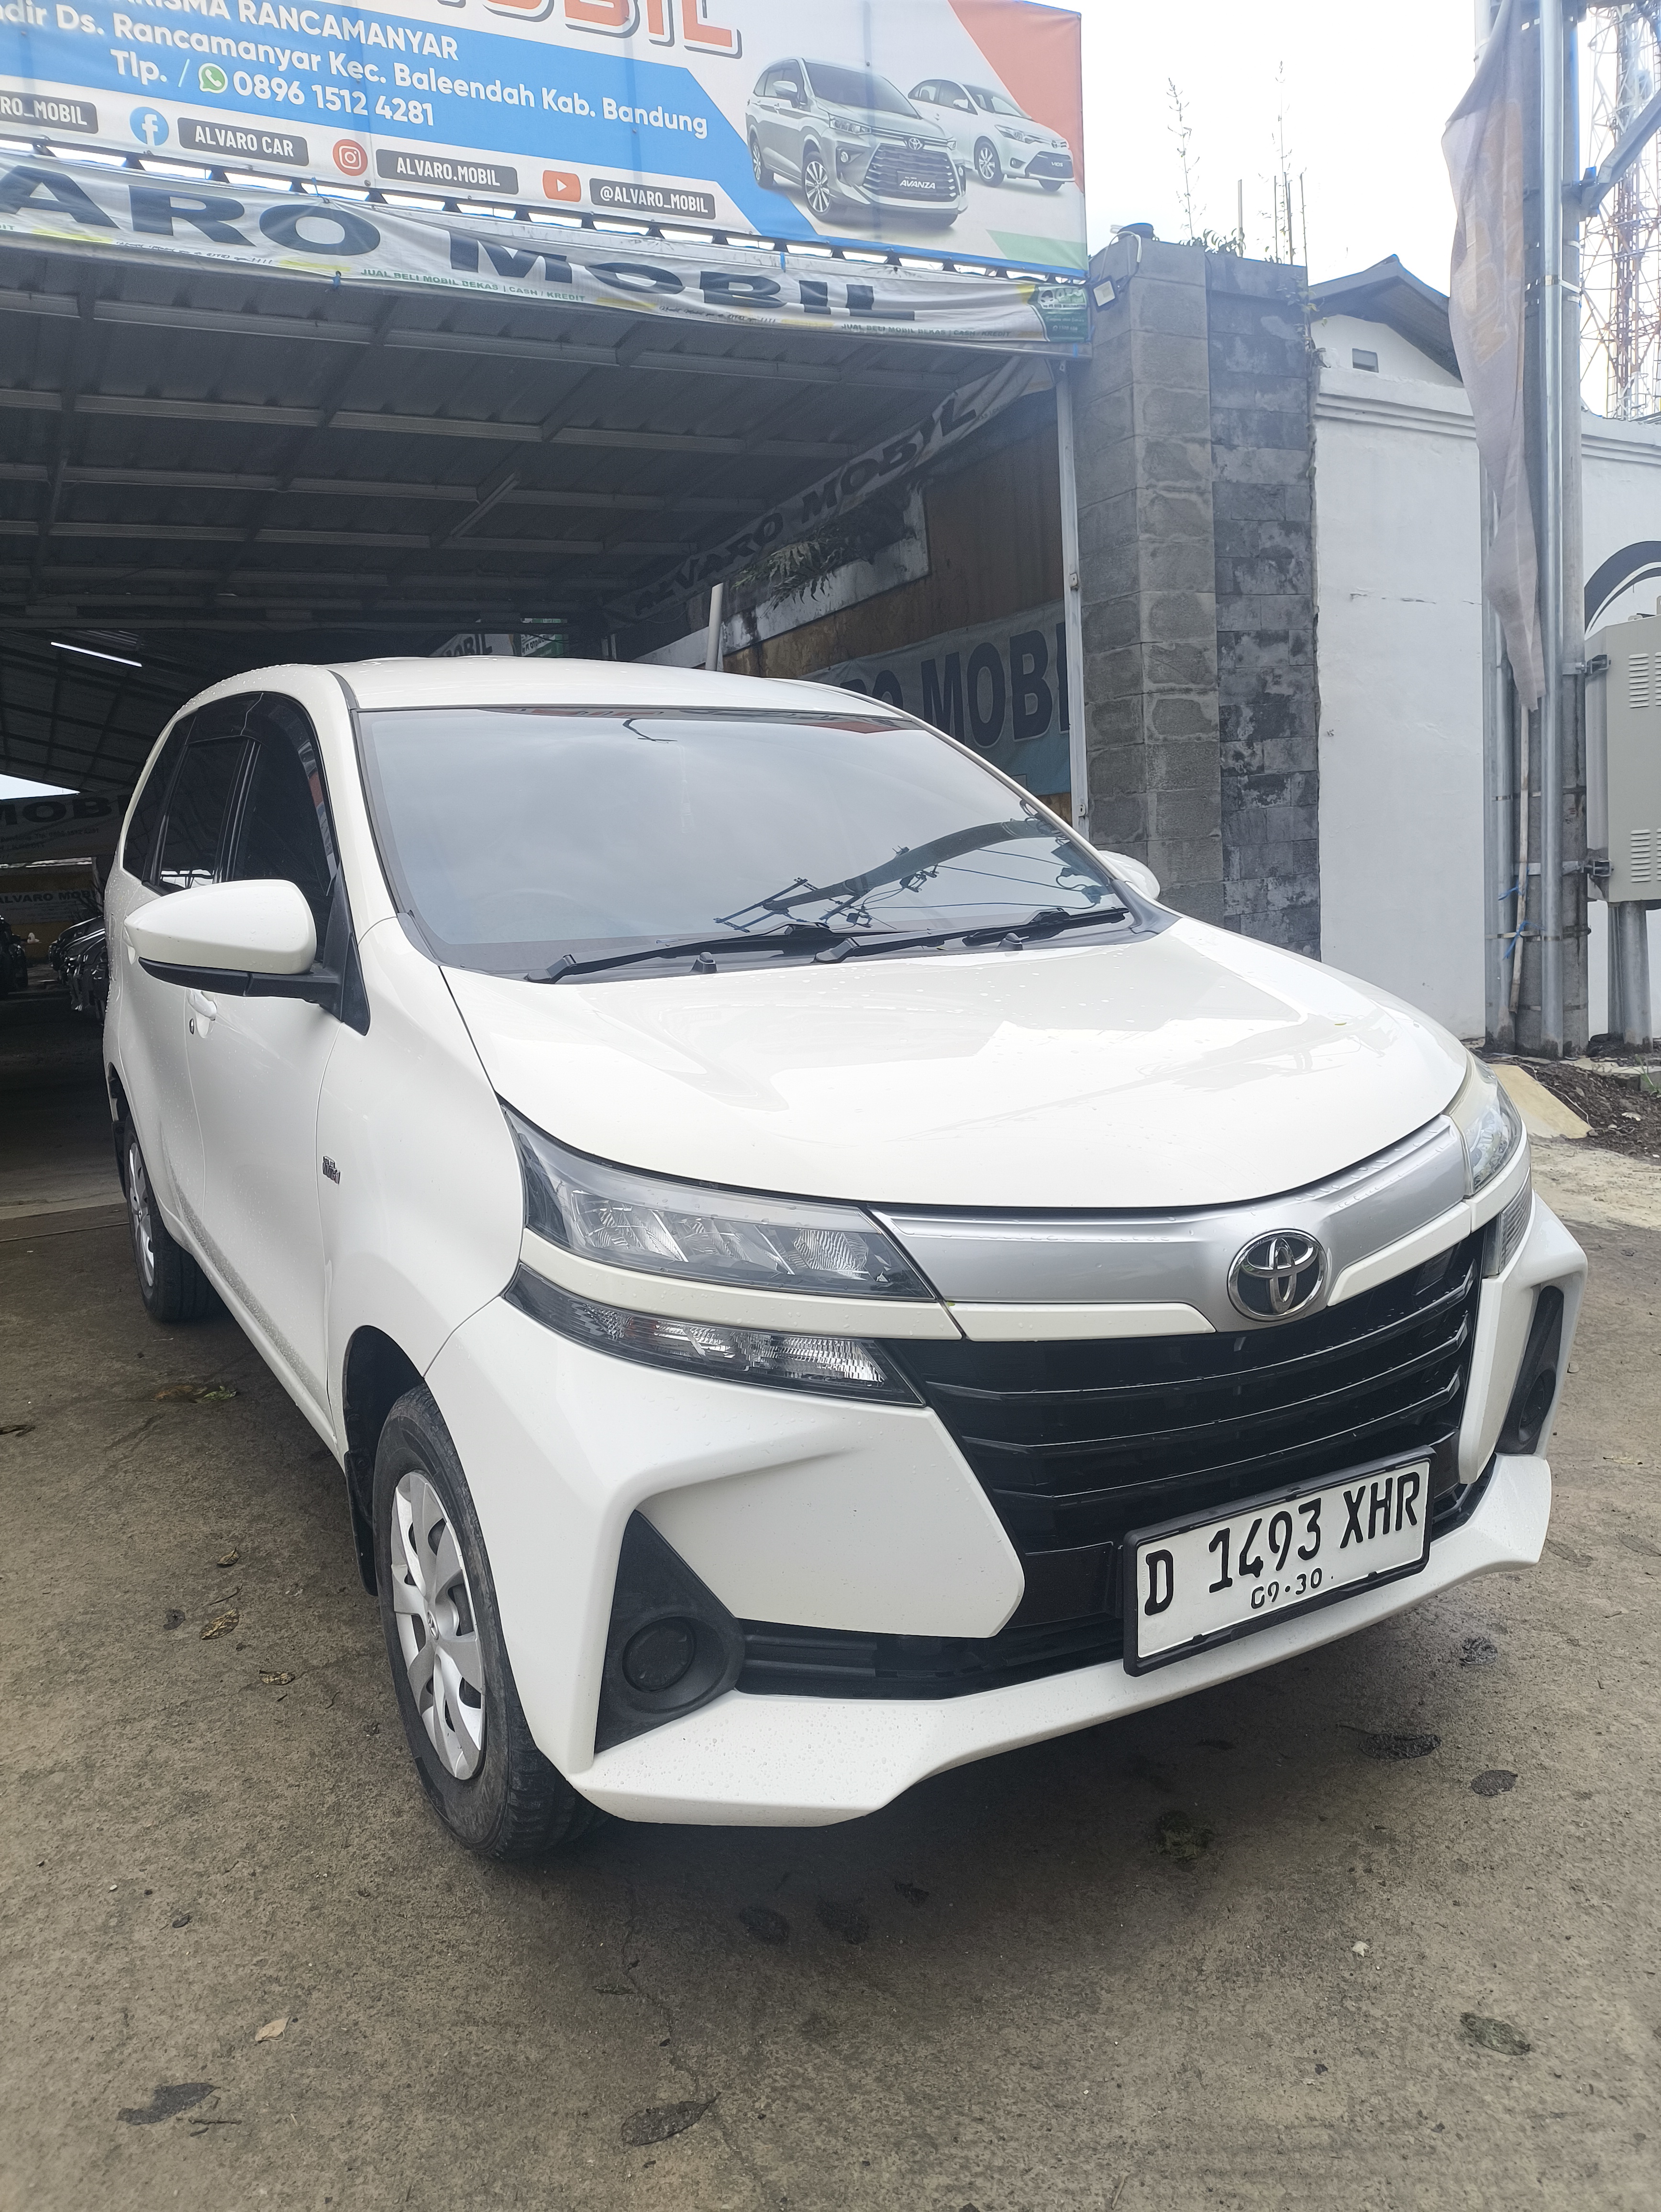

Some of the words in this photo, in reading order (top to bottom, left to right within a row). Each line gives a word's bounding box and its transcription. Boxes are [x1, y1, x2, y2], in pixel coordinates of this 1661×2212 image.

[239, 1, 459, 61] RANCAMANYAR
[56, 4, 105, 35] Ds.
[113, 12, 321, 72] Rancamanyar
[329, 50, 387, 84] Kec.
[394, 62, 535, 108] Baleendah
[542, 87, 596, 118] Kab.
[602, 97, 708, 140] Bandung
[110, 49, 167, 86] Tlp.
[233, 70, 306, 105] 0896
[311, 84, 368, 116] 1512
[375, 95, 434, 126] 4281
[195, 125, 258, 152] ALVARO
[261, 137, 295, 158] CAR
[396, 156, 501, 187] ALVARO.MOBIL
[899, 179, 936, 189] AVANZA
[599, 185, 709, 214] @ALVARO_MOBIL
[360, 268, 391, 278] JUAL
[393, 272, 420, 281] BELI
[423, 276, 460, 286] MOBIL
[509, 287, 538, 296] CASH
[546, 291, 586, 302] KREDIT
[449, 230, 915, 321] MOBIL
[1144, 1549, 1174, 1616] D
[1208, 1497, 1322, 1594] 1493
[1339, 1471, 1420, 1549] XHR
